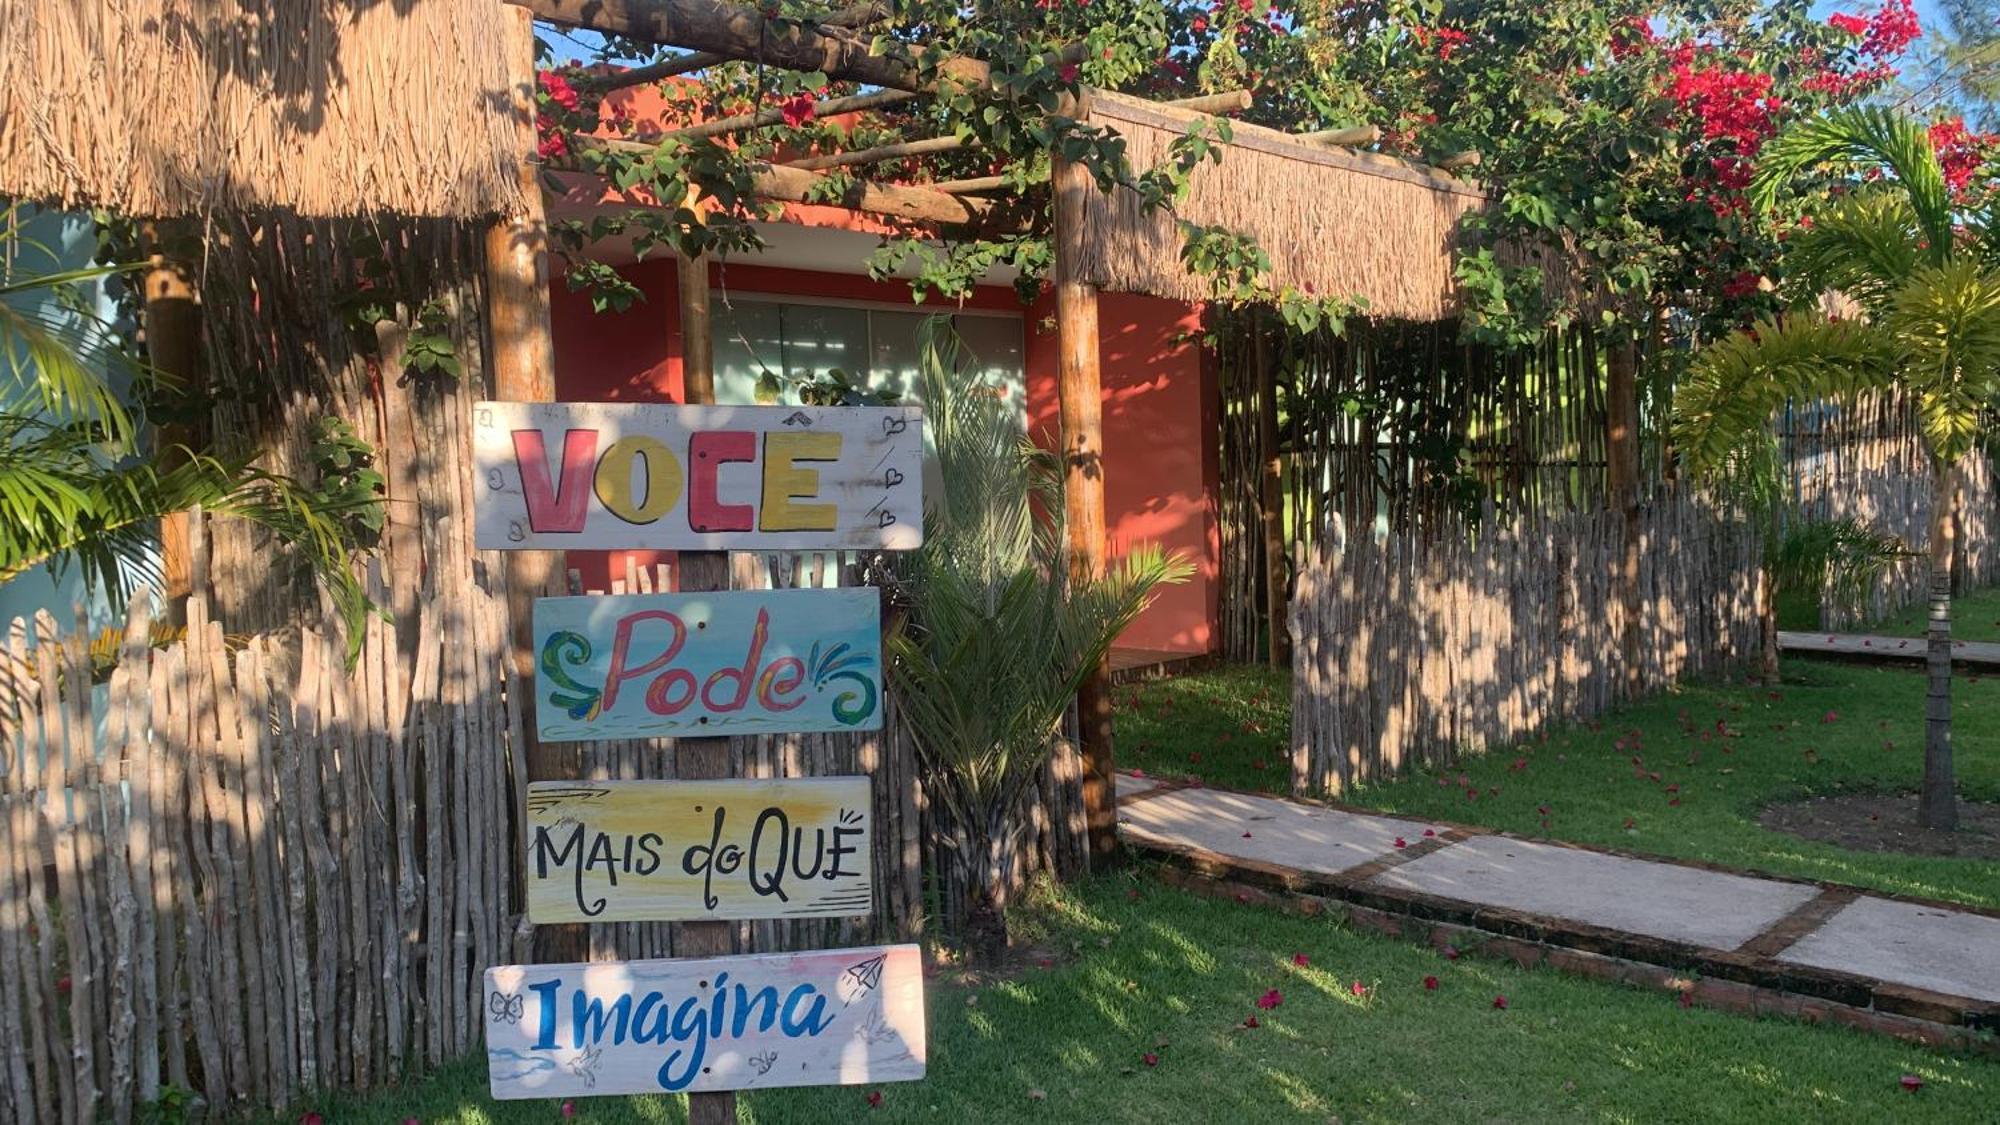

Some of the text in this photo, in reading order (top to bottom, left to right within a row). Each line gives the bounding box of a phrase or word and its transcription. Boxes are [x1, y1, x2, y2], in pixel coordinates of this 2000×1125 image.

[511, 412, 843, 533] VOCÊ
[602, 606, 807, 715] Pode
[535, 822, 664, 916] MAIS
[682, 806, 746, 911] do
[528, 971, 836, 1091] Imagina
